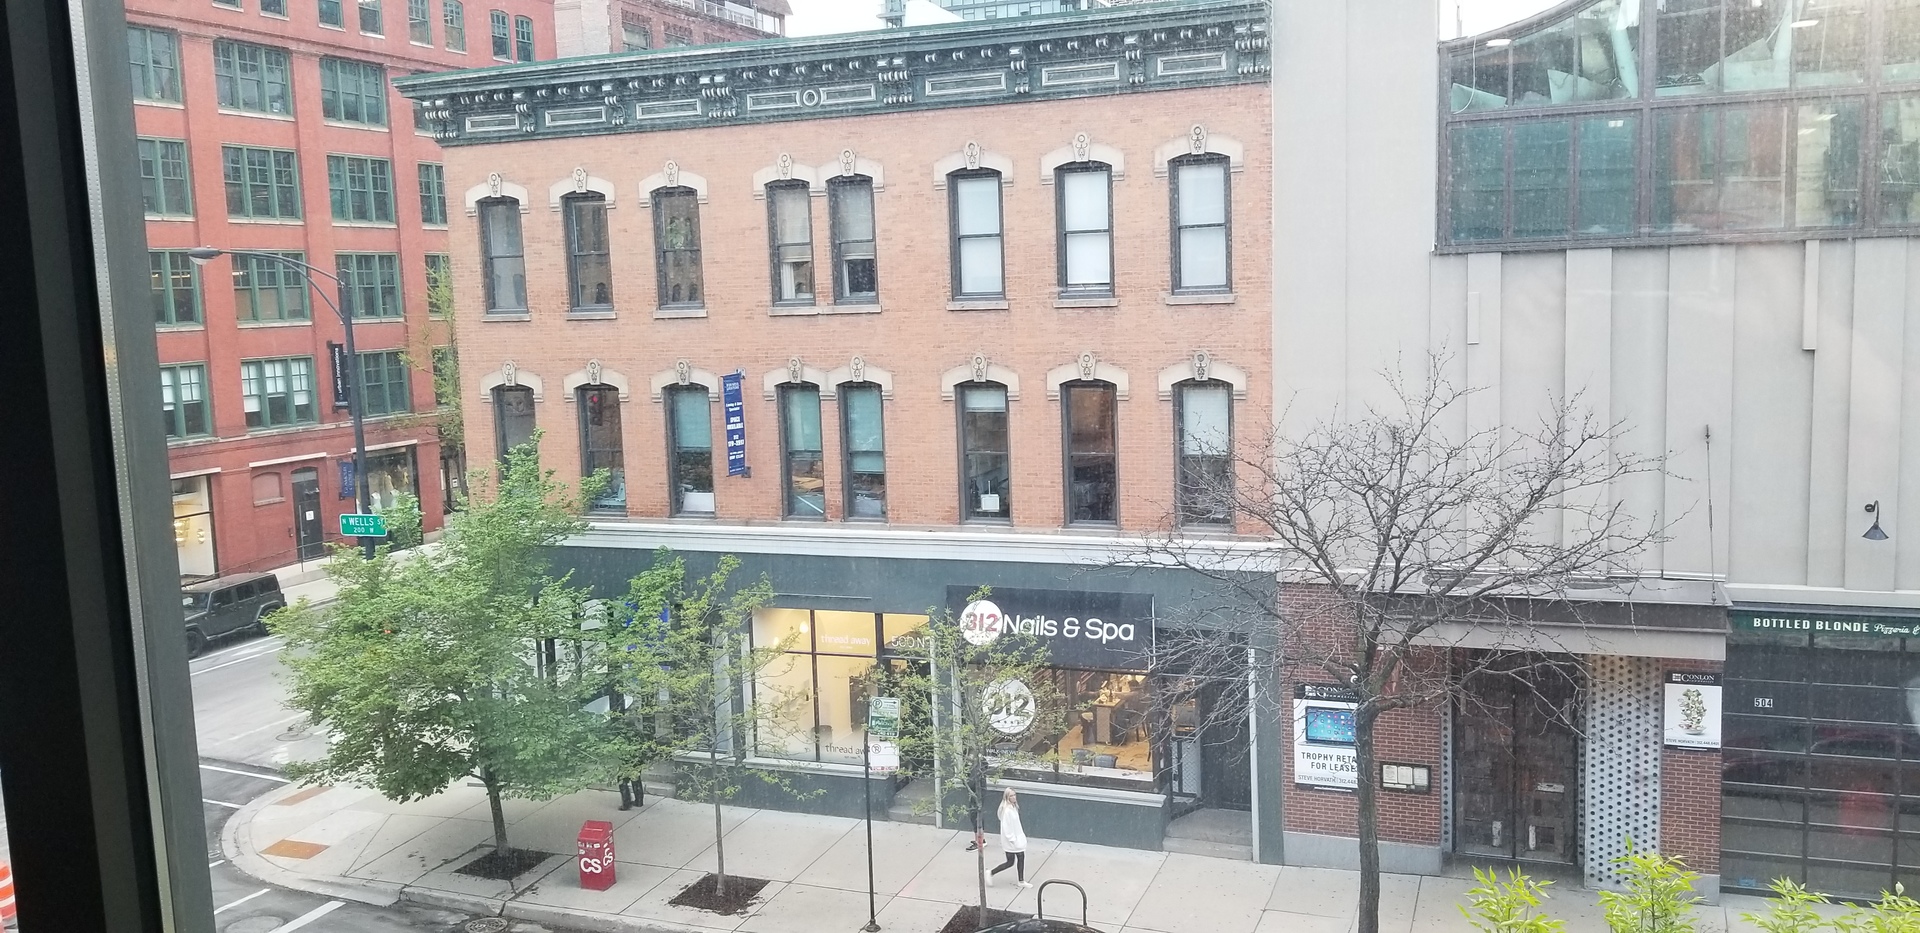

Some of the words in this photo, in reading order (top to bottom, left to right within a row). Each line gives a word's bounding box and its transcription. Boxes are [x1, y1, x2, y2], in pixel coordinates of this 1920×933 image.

[348, 517, 374, 526] WELLS
[966, 611, 999, 633] 312
[1003, 614, 1058, 637] Nails
[1062, 617, 1081, 638] &
[1084, 618, 1135, 644] Spa
[1753, 617, 1811, 630] BOTTLED
[1815, 620, 1870, 633] BLONDE
[1873, 623, 1910, 635] Pizzeria
[821, 634, 849, 645] thread
[850, 637, 871, 646] away
[1681, 673, 1715, 682] CONLON
[1755, 698, 1773, 707] 504
[825, 743, 854, 754] thread
[1301, 751, 1334, 761] TROPHY
[1336, 755, 1356, 763] RETA
[1311, 762, 1327, 770] FOR
[1329, 763, 1357, 773] LEASE
[580, 857, 602, 874] CS
